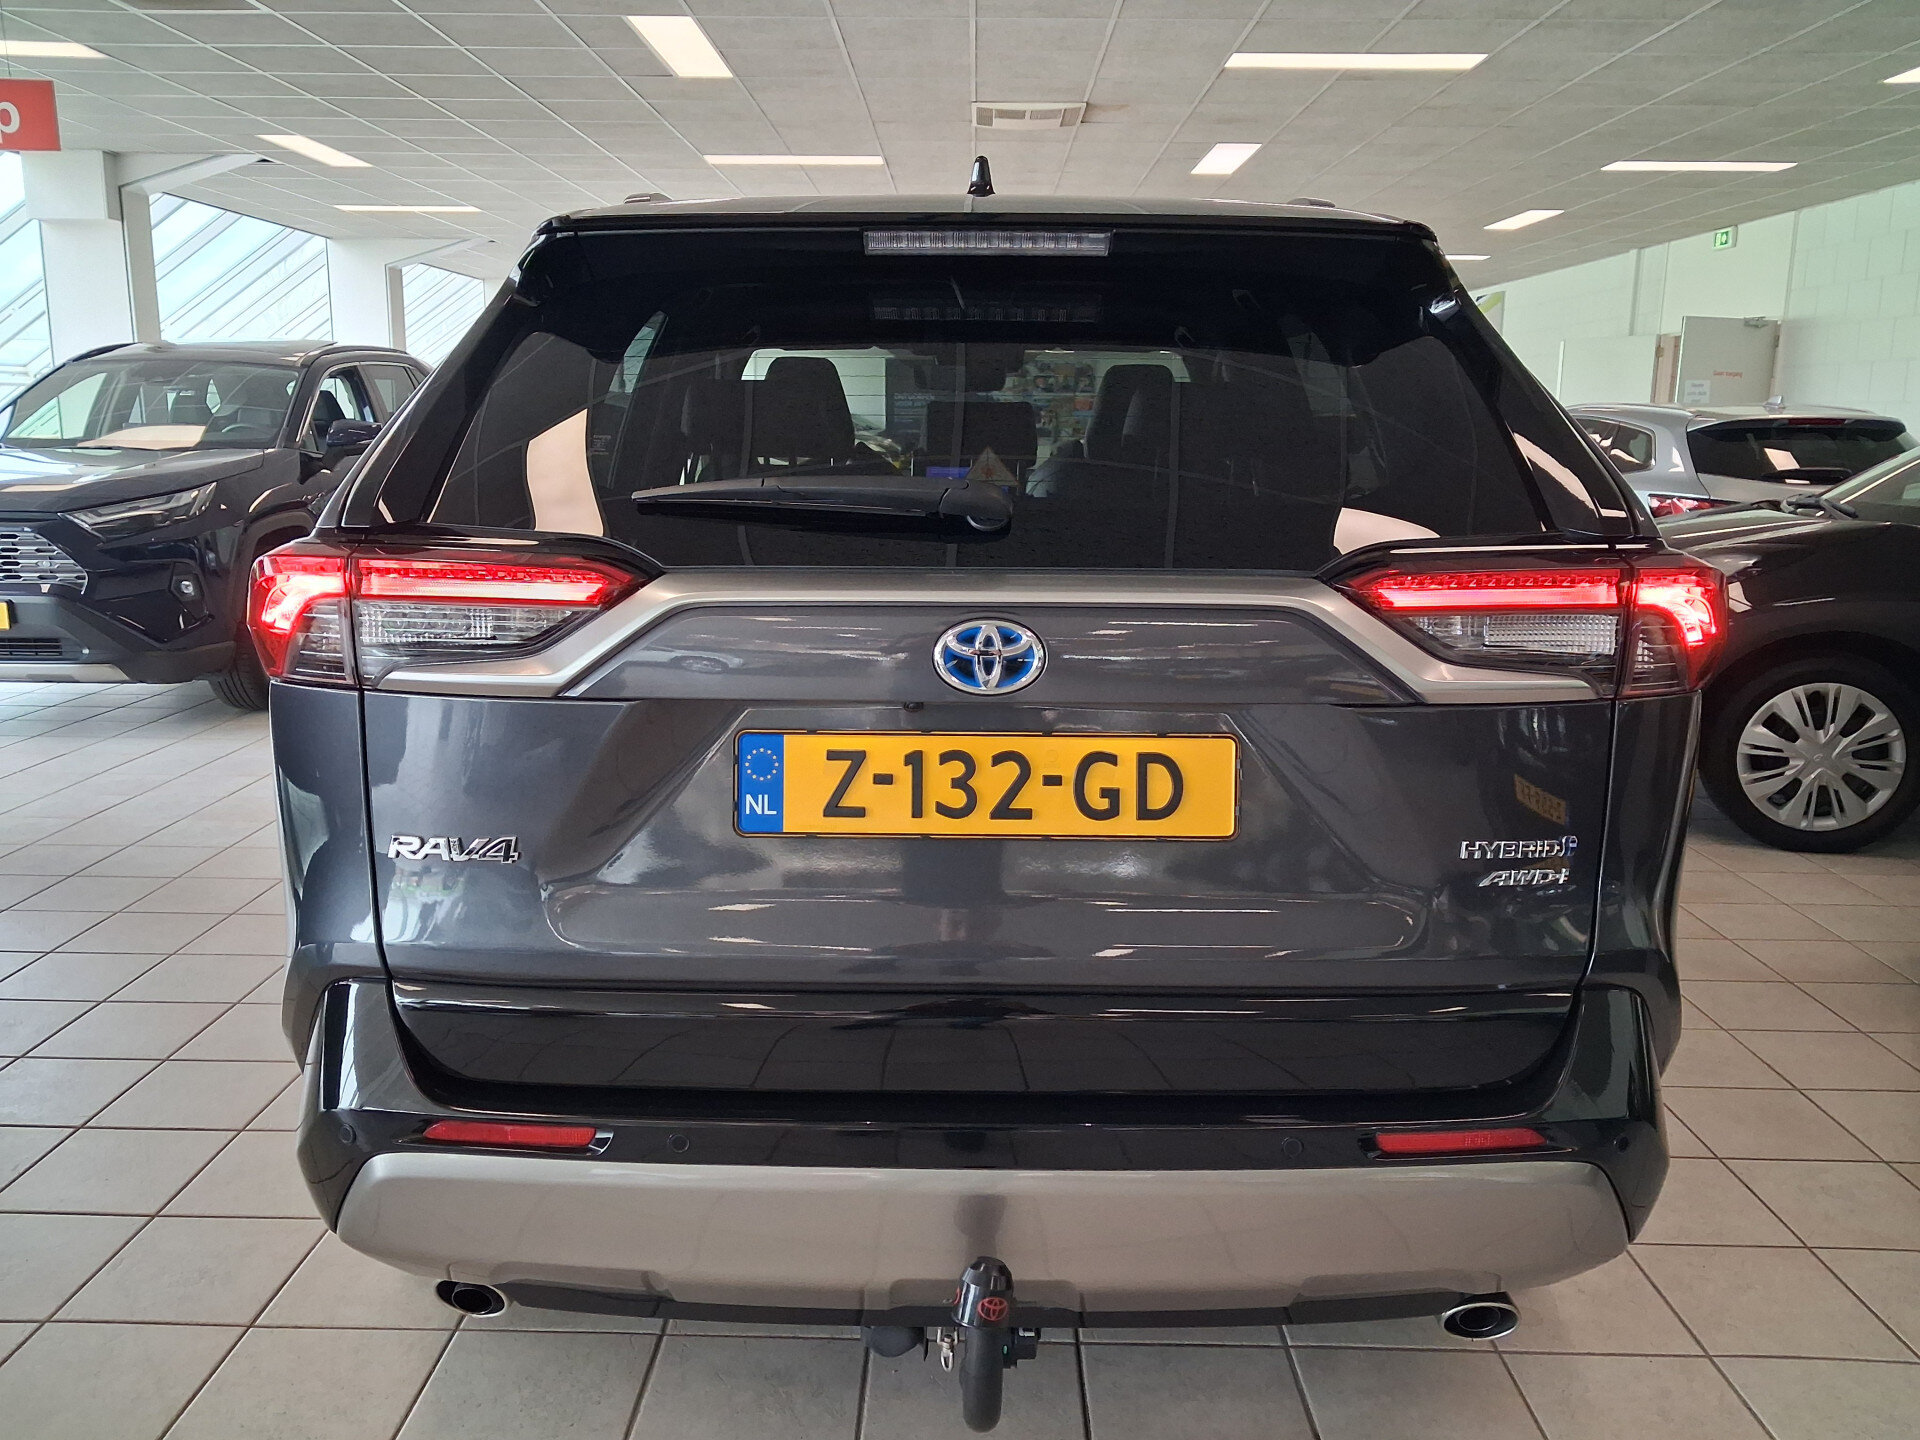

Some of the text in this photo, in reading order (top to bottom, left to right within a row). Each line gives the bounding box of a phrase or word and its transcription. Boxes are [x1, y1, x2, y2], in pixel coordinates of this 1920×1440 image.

[822, 748, 1184, 822] Z-132-GD
[744, 794, 778, 816] NL
[387, 834, 519, 864] RAV4
[1460, 840, 1564, 859] HYBRID
